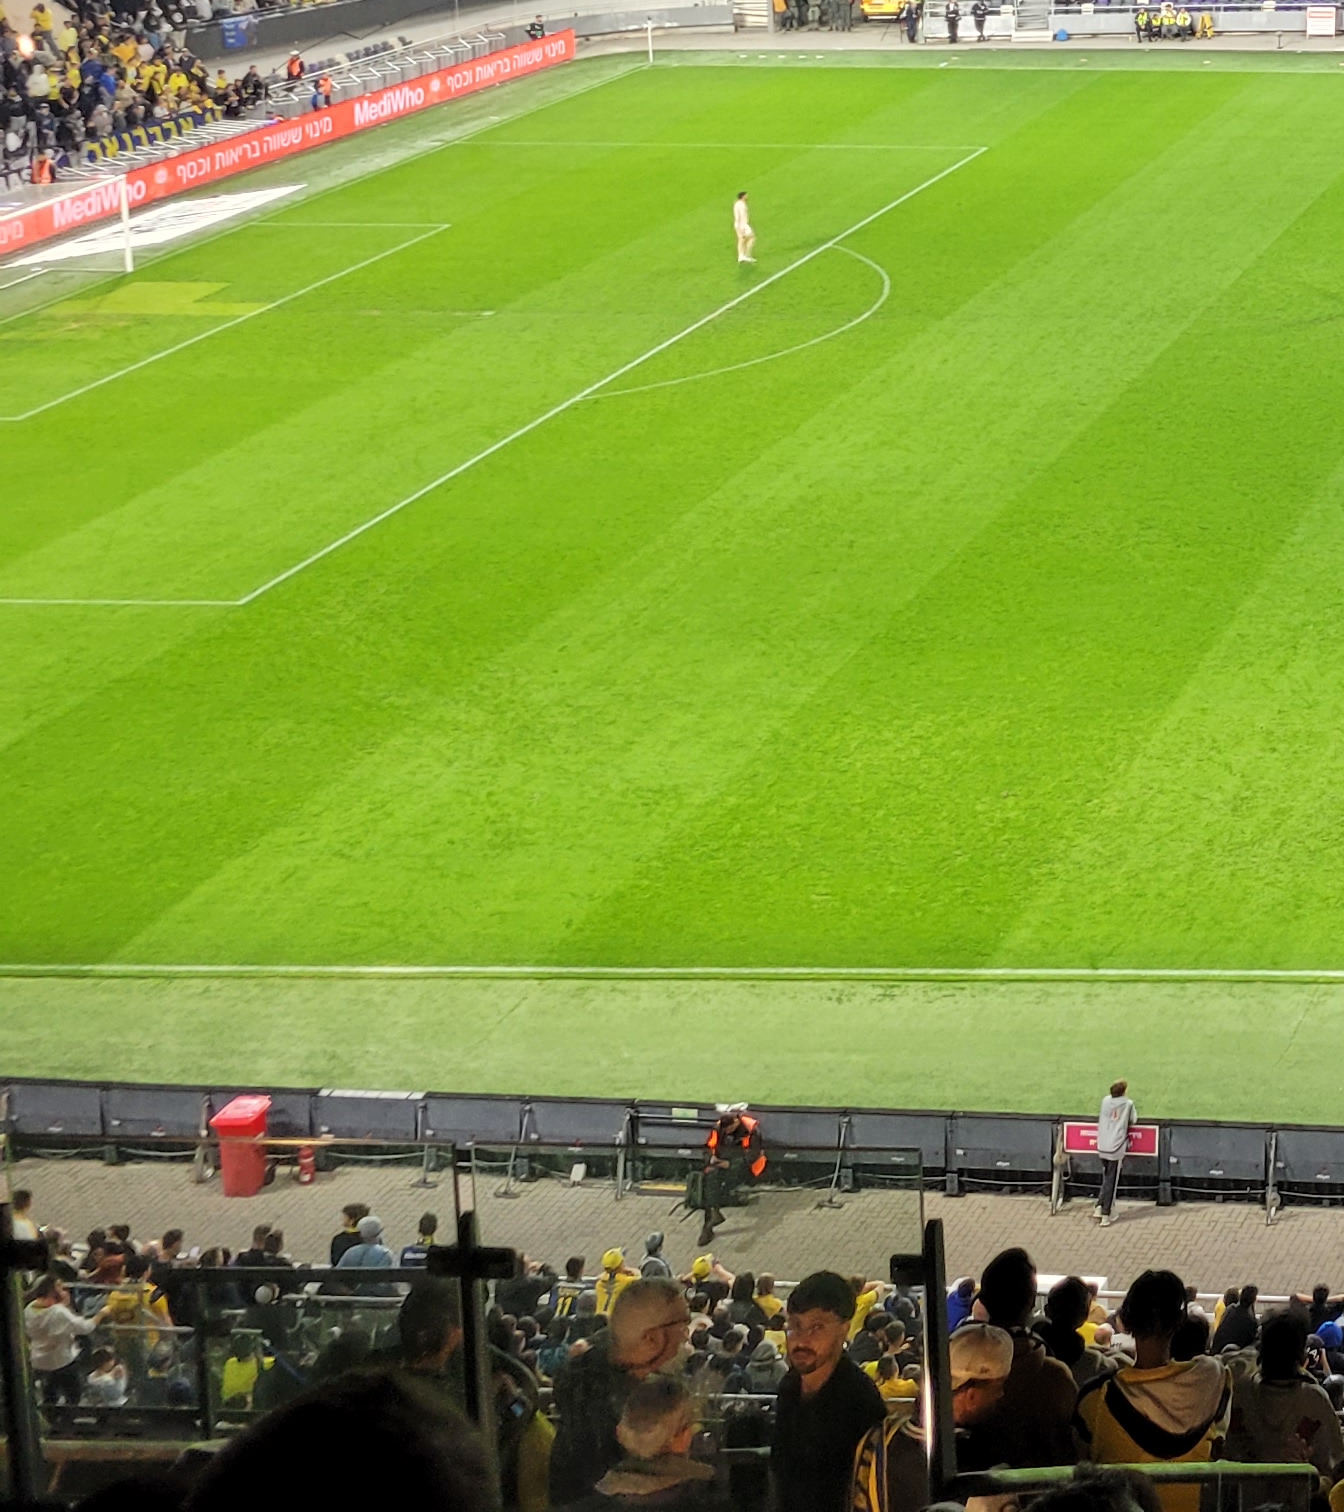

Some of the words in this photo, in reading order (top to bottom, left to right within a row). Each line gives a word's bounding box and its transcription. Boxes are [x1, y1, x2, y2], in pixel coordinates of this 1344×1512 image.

[513, 49, 543, 70] ששווה
[544, 39, 566, 60] מינוי
[447, 69, 473, 93] וכסף
[475, 57, 511, 83] בריאות
[353, 87, 425, 127] MediWho
[263, 126, 302, 154] ששווה
[305, 116, 333, 138] מינוי
[214, 142, 261, 171] בריאות
[176, 157, 210, 185] וכסף
